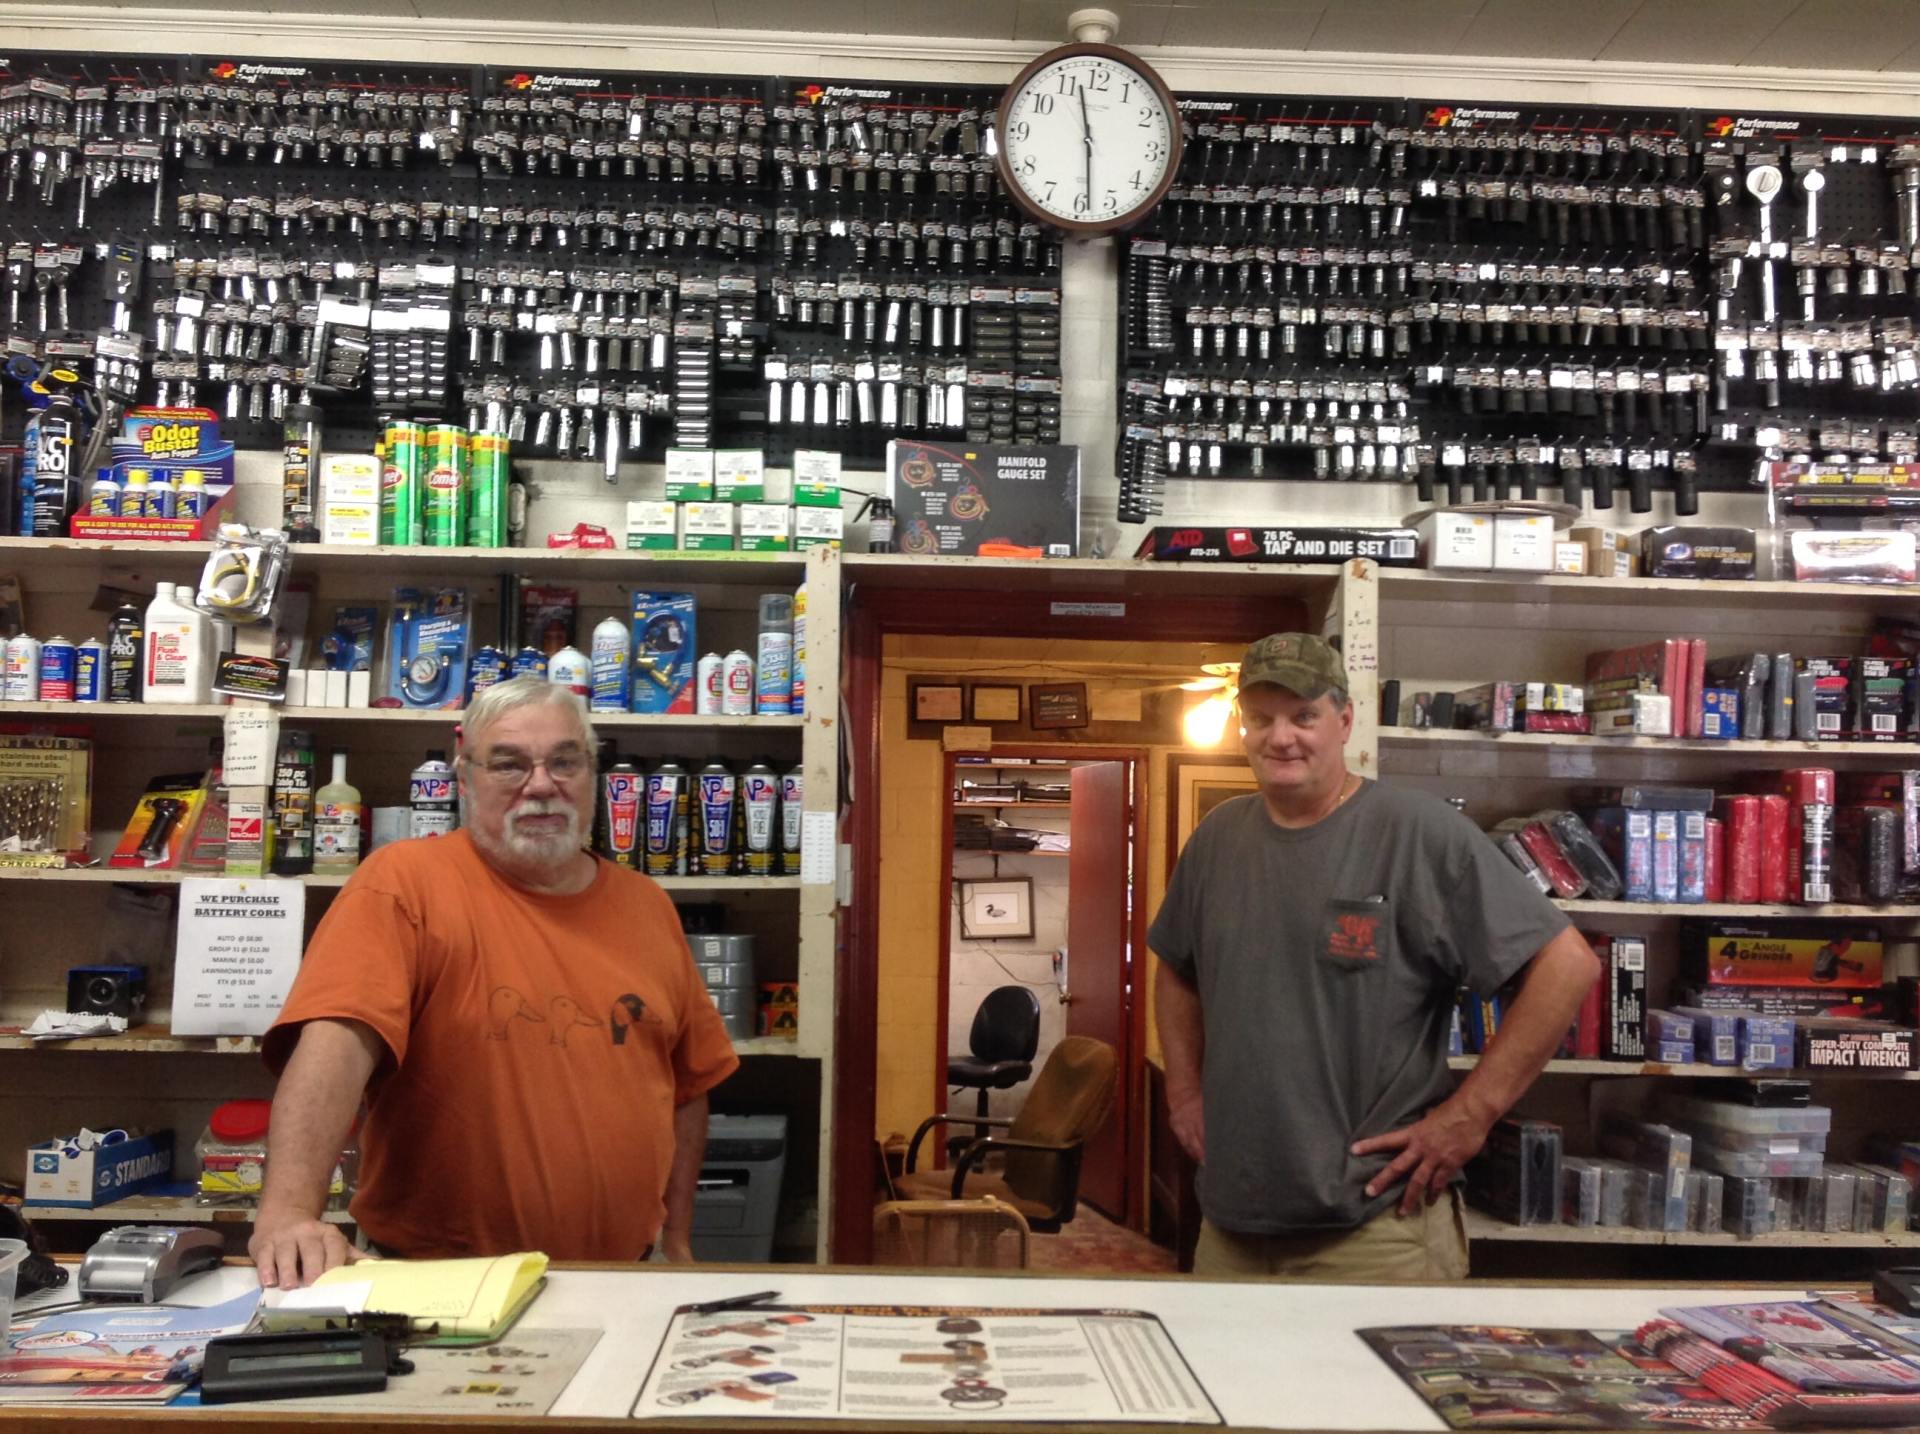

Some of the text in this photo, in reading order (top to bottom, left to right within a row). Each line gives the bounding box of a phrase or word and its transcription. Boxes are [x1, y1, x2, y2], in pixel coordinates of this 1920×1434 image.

[534, 74, 601, 88] Performance
[1056, 74, 1077, 96] 11
[1088, 69, 1111, 92] 12
[1120, 83, 1129, 104] 1
[1033, 93, 1054, 115] 10
[1176, 99, 1233, 111] erformance
[1138, 106, 1153, 128] 2
[1736, 118, 1800, 130] Performance
[1017, 121, 1030, 142] 9
[1732, 127, 1753, 137] Tool
[1145, 141, 1159, 162] 3
[1022, 154, 1036, 175] 8
[1128, 169, 1142, 190] 4
[1044, 181, 1057, 201] 7
[1103, 189, 1117, 210] 5
[1073, 192, 1087, 214] 6
[151, 424, 200, 442] Odor
[143, 438, 199, 453] Buster
[998, 456, 1047, 468] MANIFOLD
[997, 469, 1047, 480] GAUGE SET
[1263, 530, 1296, 541] 76 PC.
[1263, 540, 1386, 556] TAP AND DIE SET
[111, 645, 136, 655] PRO
[157, 646, 179, 654] Flush
[609, 779, 629, 801] VP
[703, 780, 723, 802] VP
[745, 779, 765, 801] VP
[200, 895, 280, 905] WE PURCHASE
[194, 908, 287, 918] BATTERY CORES
[1719, 941, 1738, 960] 4
[1810, 1039, 1861, 1050] SUPER-DUTY
[1810, 1049, 1910, 1067] IMPACT WRENCH
[115, 1149, 170, 1187] STANDARD
